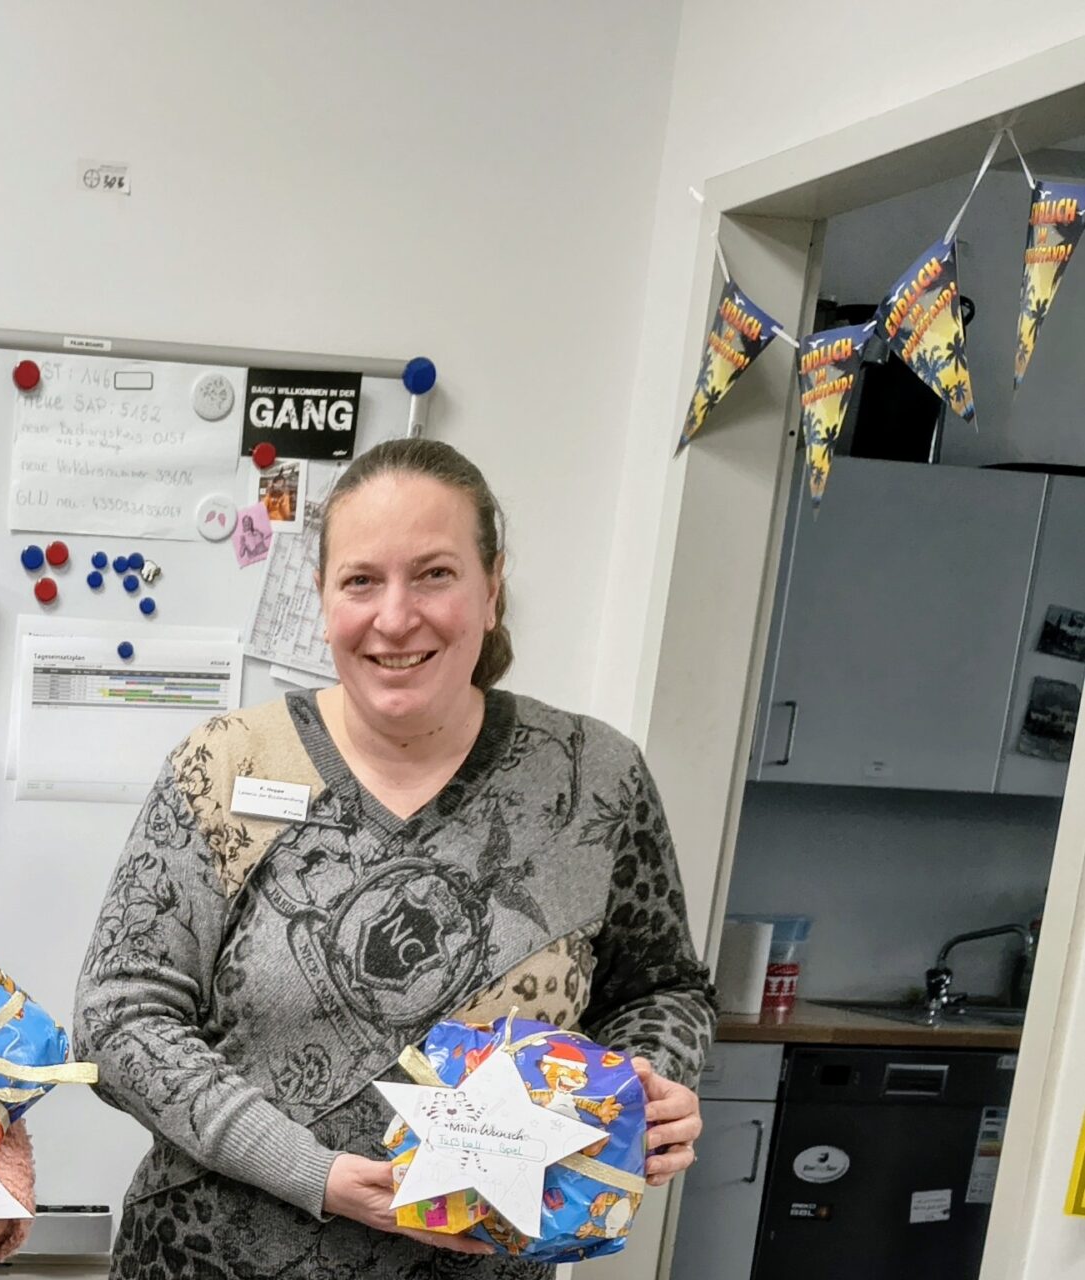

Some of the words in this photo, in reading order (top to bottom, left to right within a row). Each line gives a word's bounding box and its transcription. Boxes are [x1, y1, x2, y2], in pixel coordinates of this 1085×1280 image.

[885, 257, 943, 339] ENDLICH
[277, 387, 327, 396] WILLKOMMEN
[339, 389, 355, 398] DER
[249, 396, 354, 431] GANG
[380, 914, 426, 966] NC
[479, 1123, 524, 1141] Wunsch
